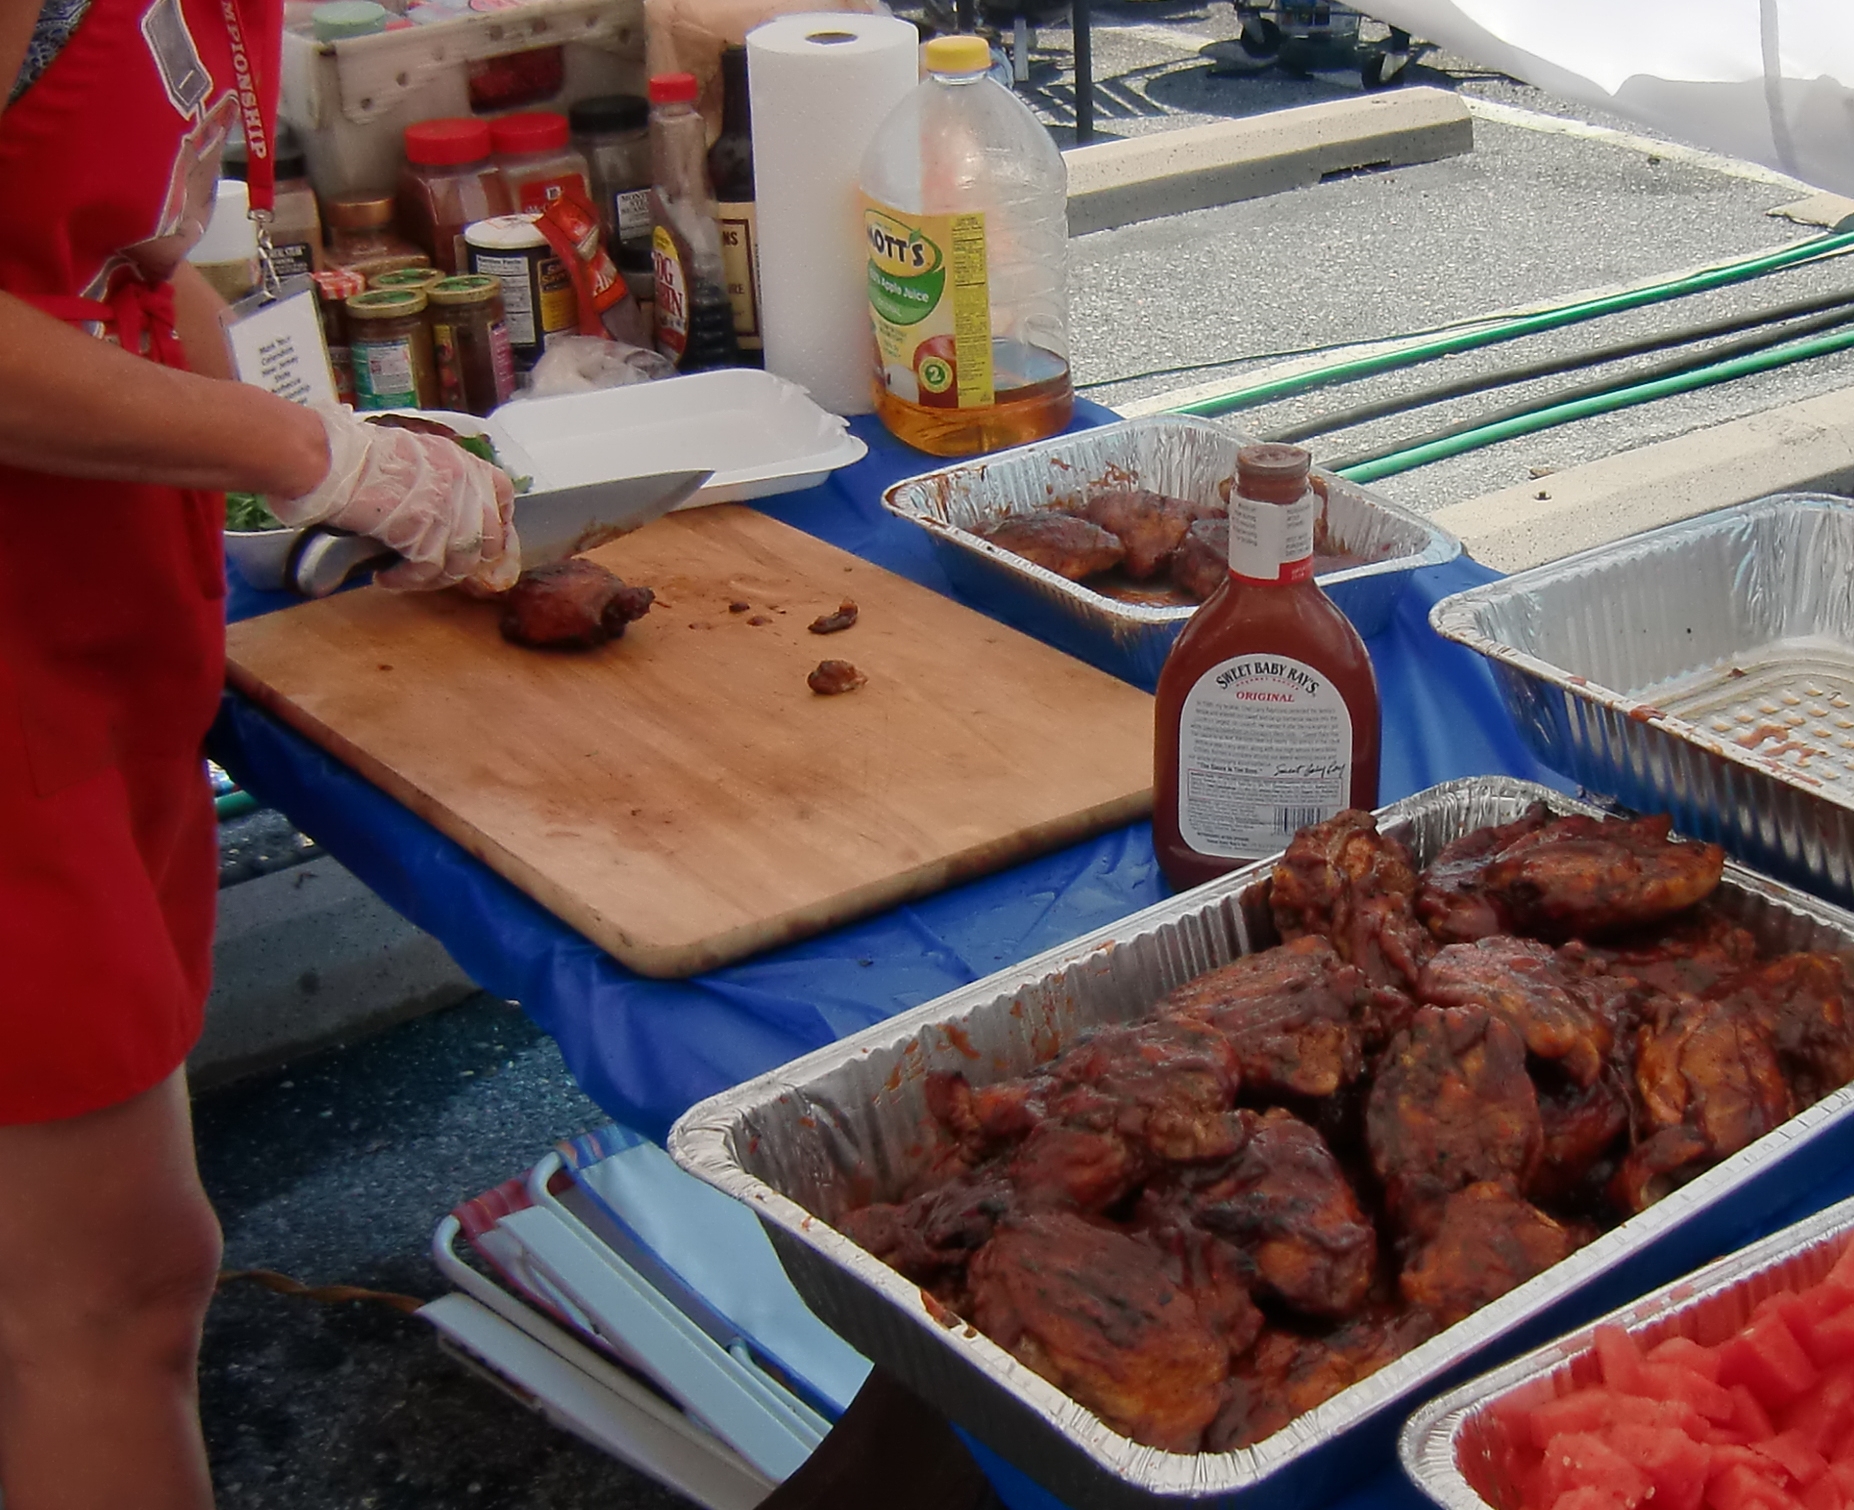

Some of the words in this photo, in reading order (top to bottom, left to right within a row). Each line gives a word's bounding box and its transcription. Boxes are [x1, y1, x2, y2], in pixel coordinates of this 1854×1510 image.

[928, 366, 942, 381] 2
[1216, 663, 1252, 690] SWEET
[1254, 662, 1287, 676] BABY
[1287, 667, 1320, 694] RAY'S
[1236, 691, 1295, 703] ORIGINAL
